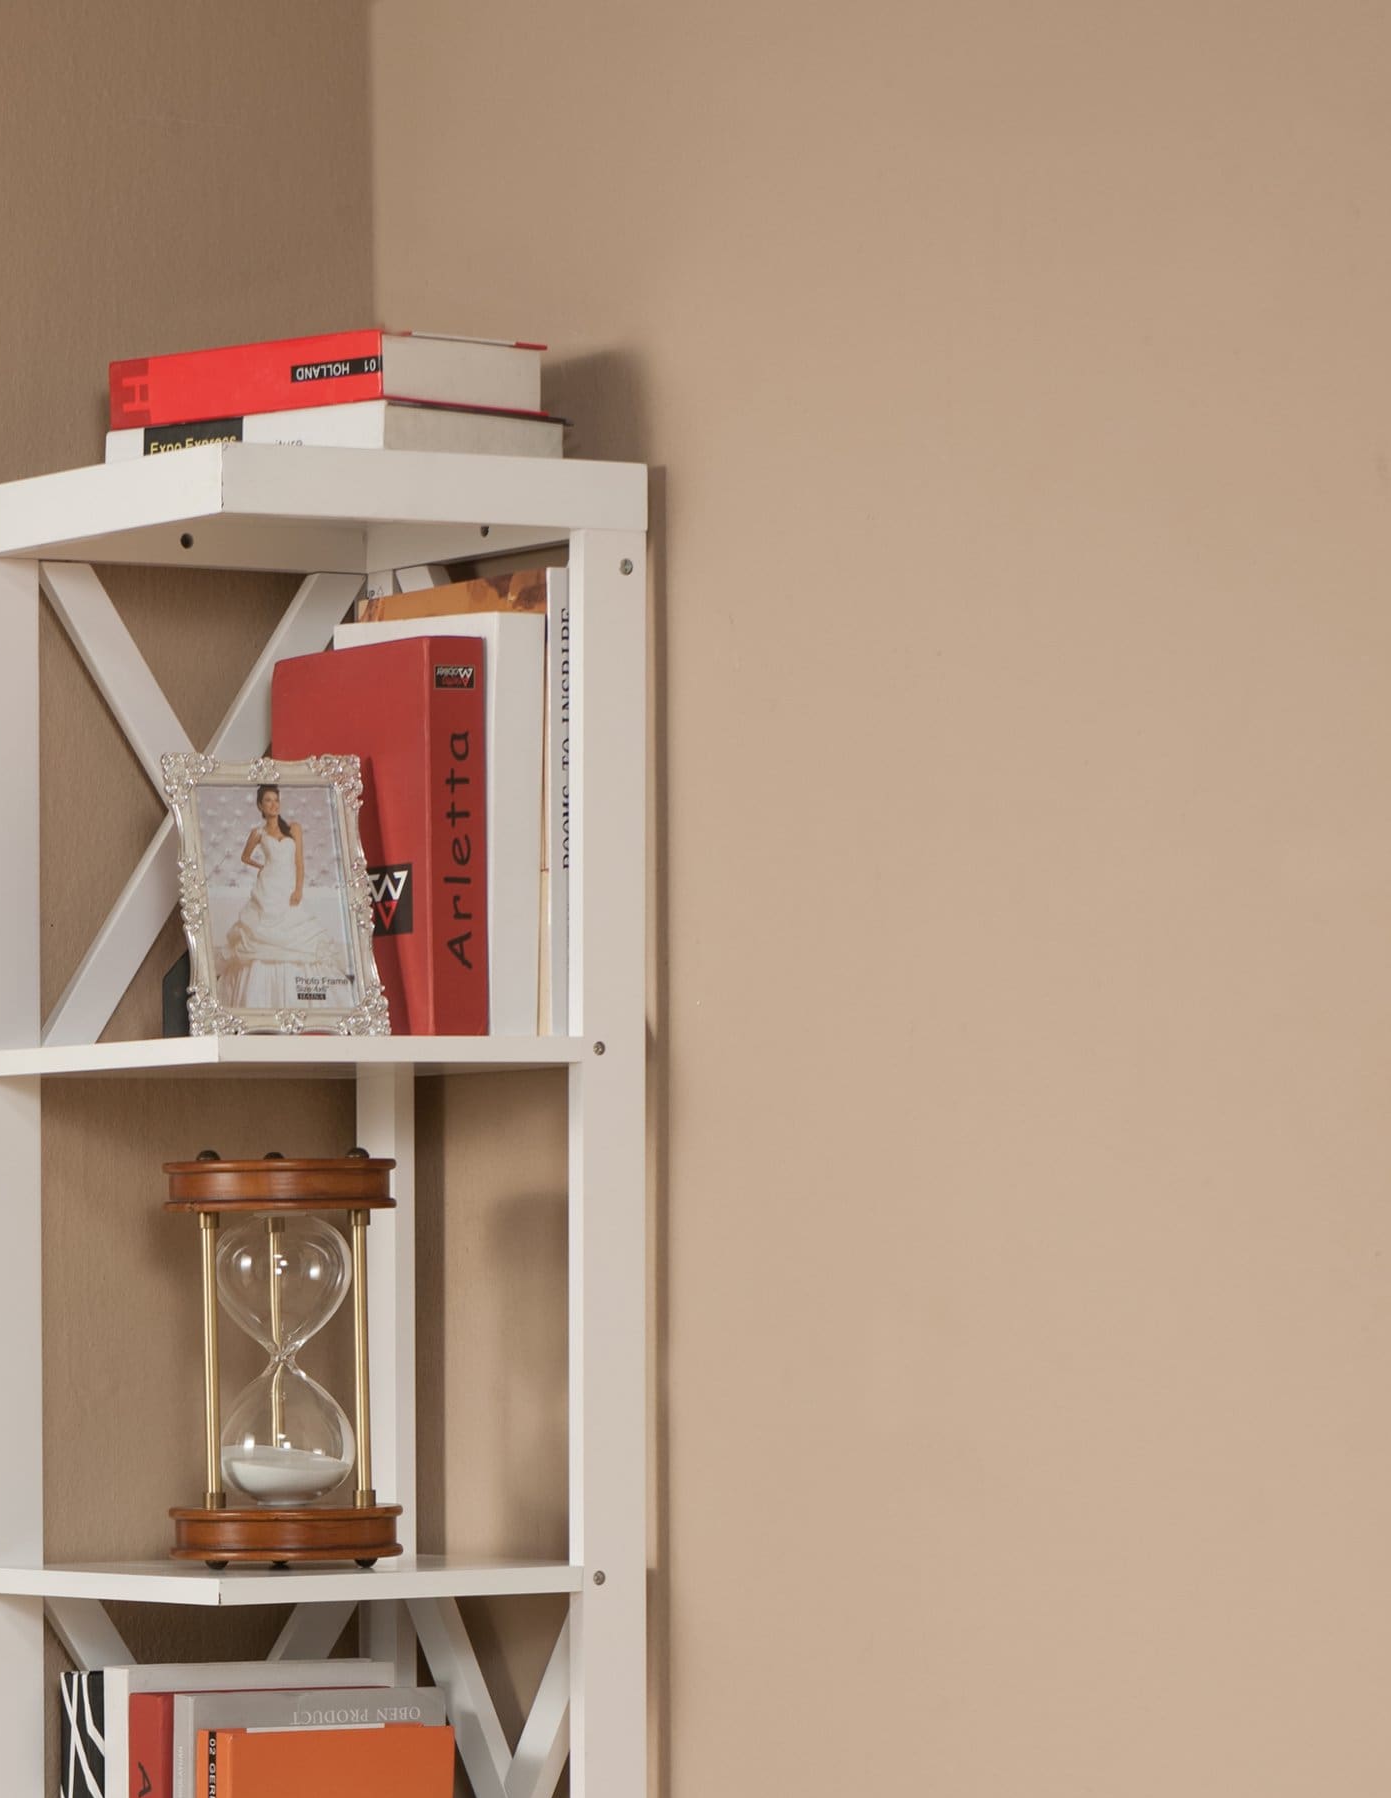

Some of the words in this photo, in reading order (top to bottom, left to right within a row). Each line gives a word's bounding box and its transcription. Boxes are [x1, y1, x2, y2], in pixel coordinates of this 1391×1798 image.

[295, 363, 350, 381] HOLLAND
[363, 358, 377, 373] 01
[442, 730, 474, 970] Arletta
[289, 1708, 368, 1725] PRODUCT
[209, 1738, 217, 1755] 02
